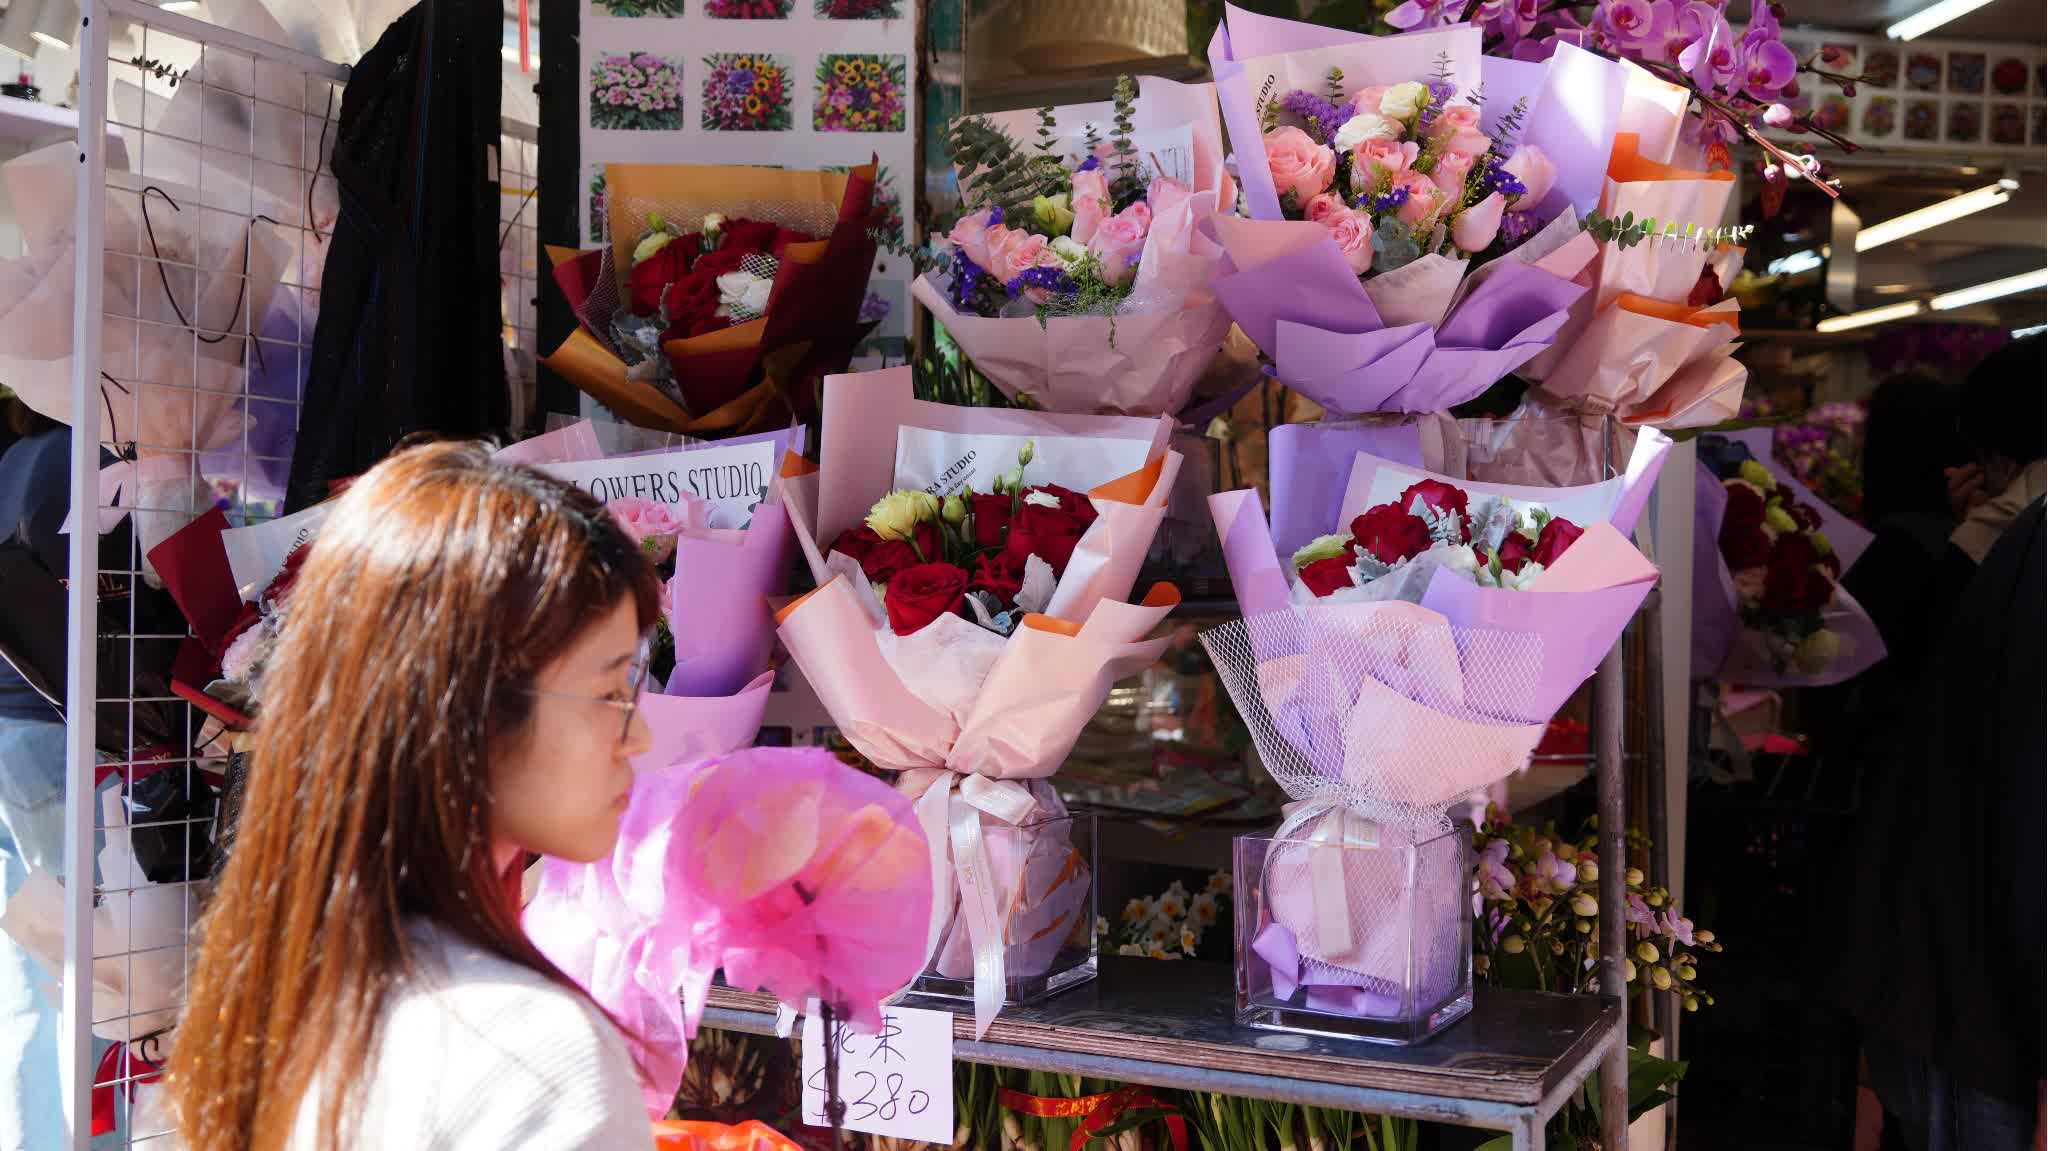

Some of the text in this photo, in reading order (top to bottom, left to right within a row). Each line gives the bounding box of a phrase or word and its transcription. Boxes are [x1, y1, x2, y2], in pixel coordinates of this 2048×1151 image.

[688, 461, 763, 500] STUDIO
[940, 450, 976, 484] STUDIO
[808, 1066, 930, 1124] $380
